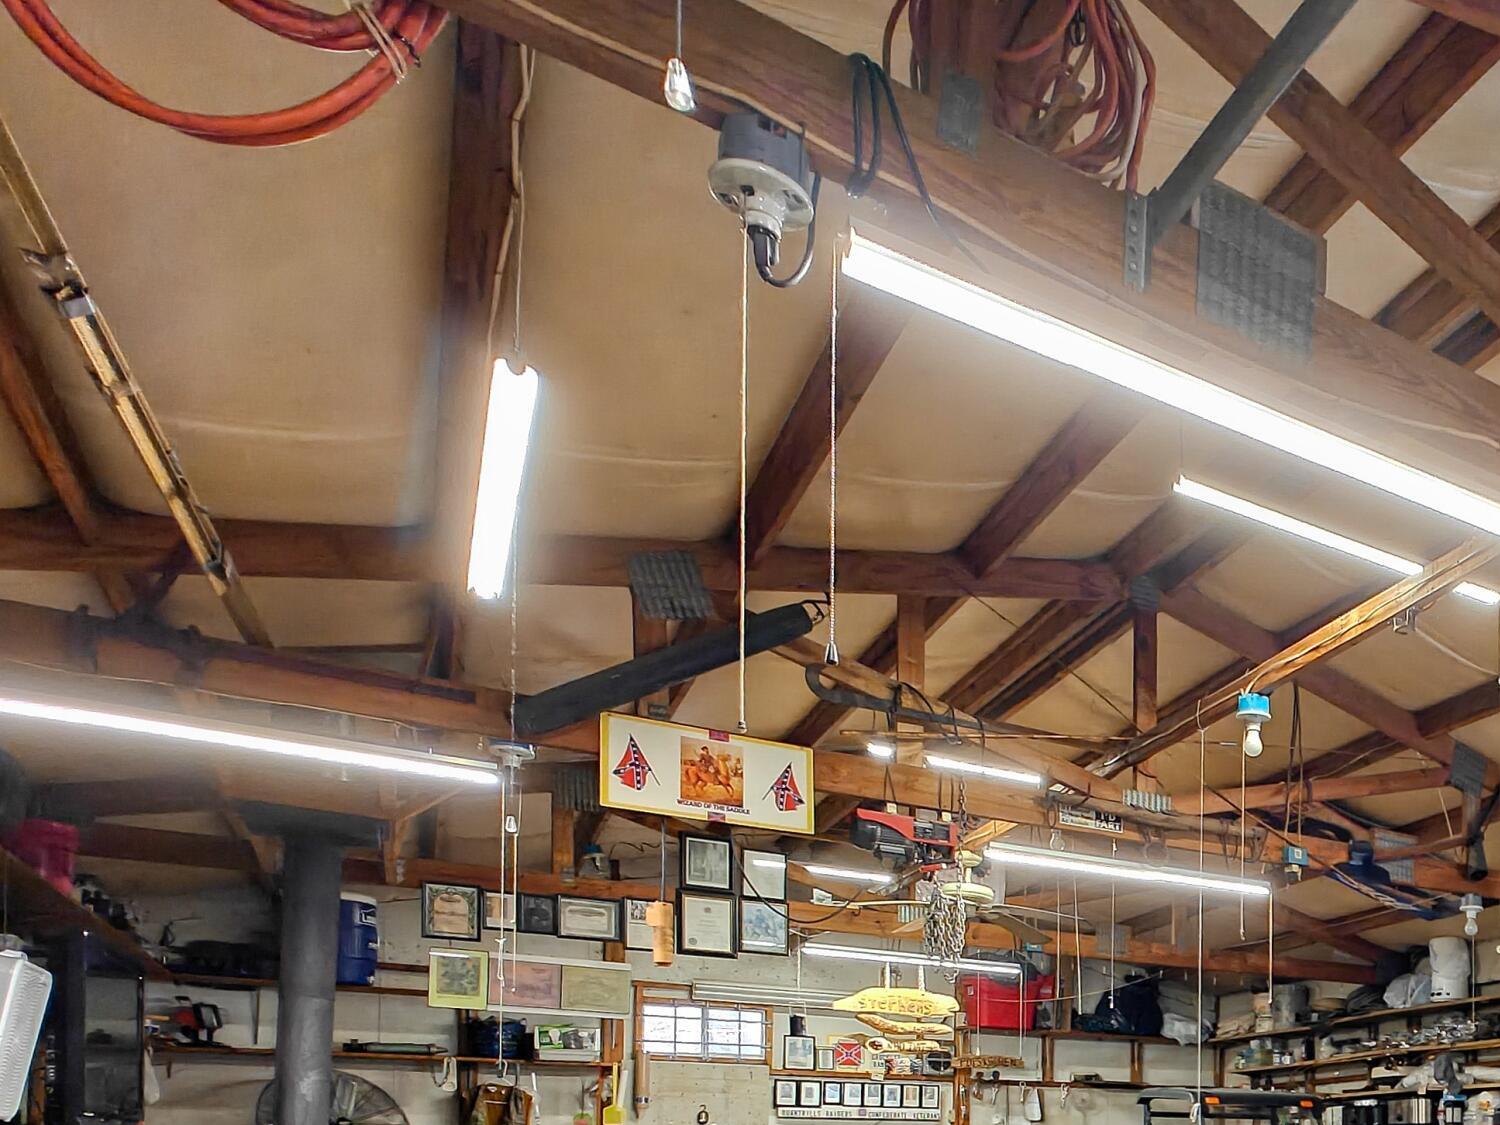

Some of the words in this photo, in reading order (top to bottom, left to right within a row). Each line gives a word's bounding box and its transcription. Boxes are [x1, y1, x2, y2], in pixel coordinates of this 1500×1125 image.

[677, 799, 702, 807] WIZARD
[726, 806, 750, 814] SADDLE
[1095, 820, 1121, 830] FART
